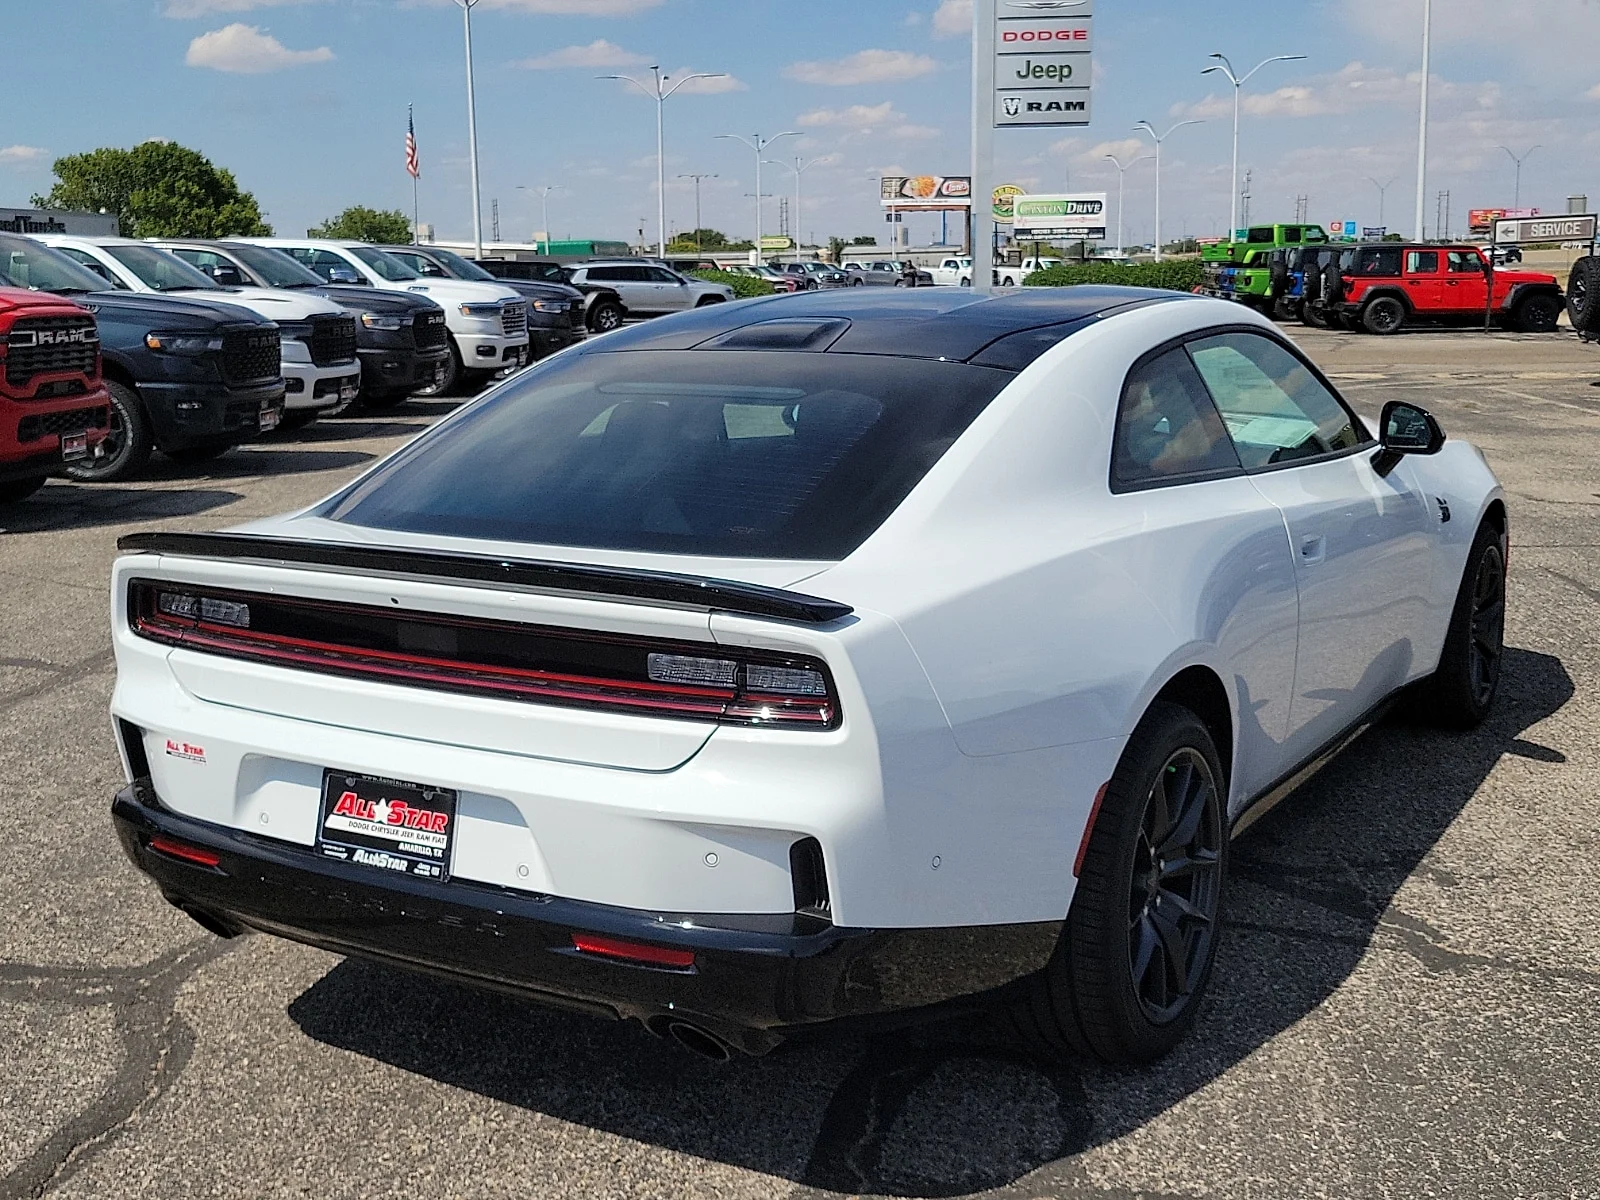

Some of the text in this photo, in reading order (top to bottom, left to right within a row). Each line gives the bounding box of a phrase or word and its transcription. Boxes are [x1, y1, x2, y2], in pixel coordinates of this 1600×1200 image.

[1003, 30, 1088, 42] DODGE
[1016, 60, 1073, 83] Jeep
[1026, 101, 1086, 112] RAM
[1066, 202, 1102, 214] DRIVE
[1530, 221, 1582, 237] SERVICE
[38, 328, 86, 345] RAM
[387, 800, 449, 834] STAR
[348, 820, 370, 831] DODGE
[370, 825, 399, 836] CHRYSLER
[416, 832, 431, 842] RAM
[432, 835, 446, 845] FIAT
[433, 848, 444, 858] TX
